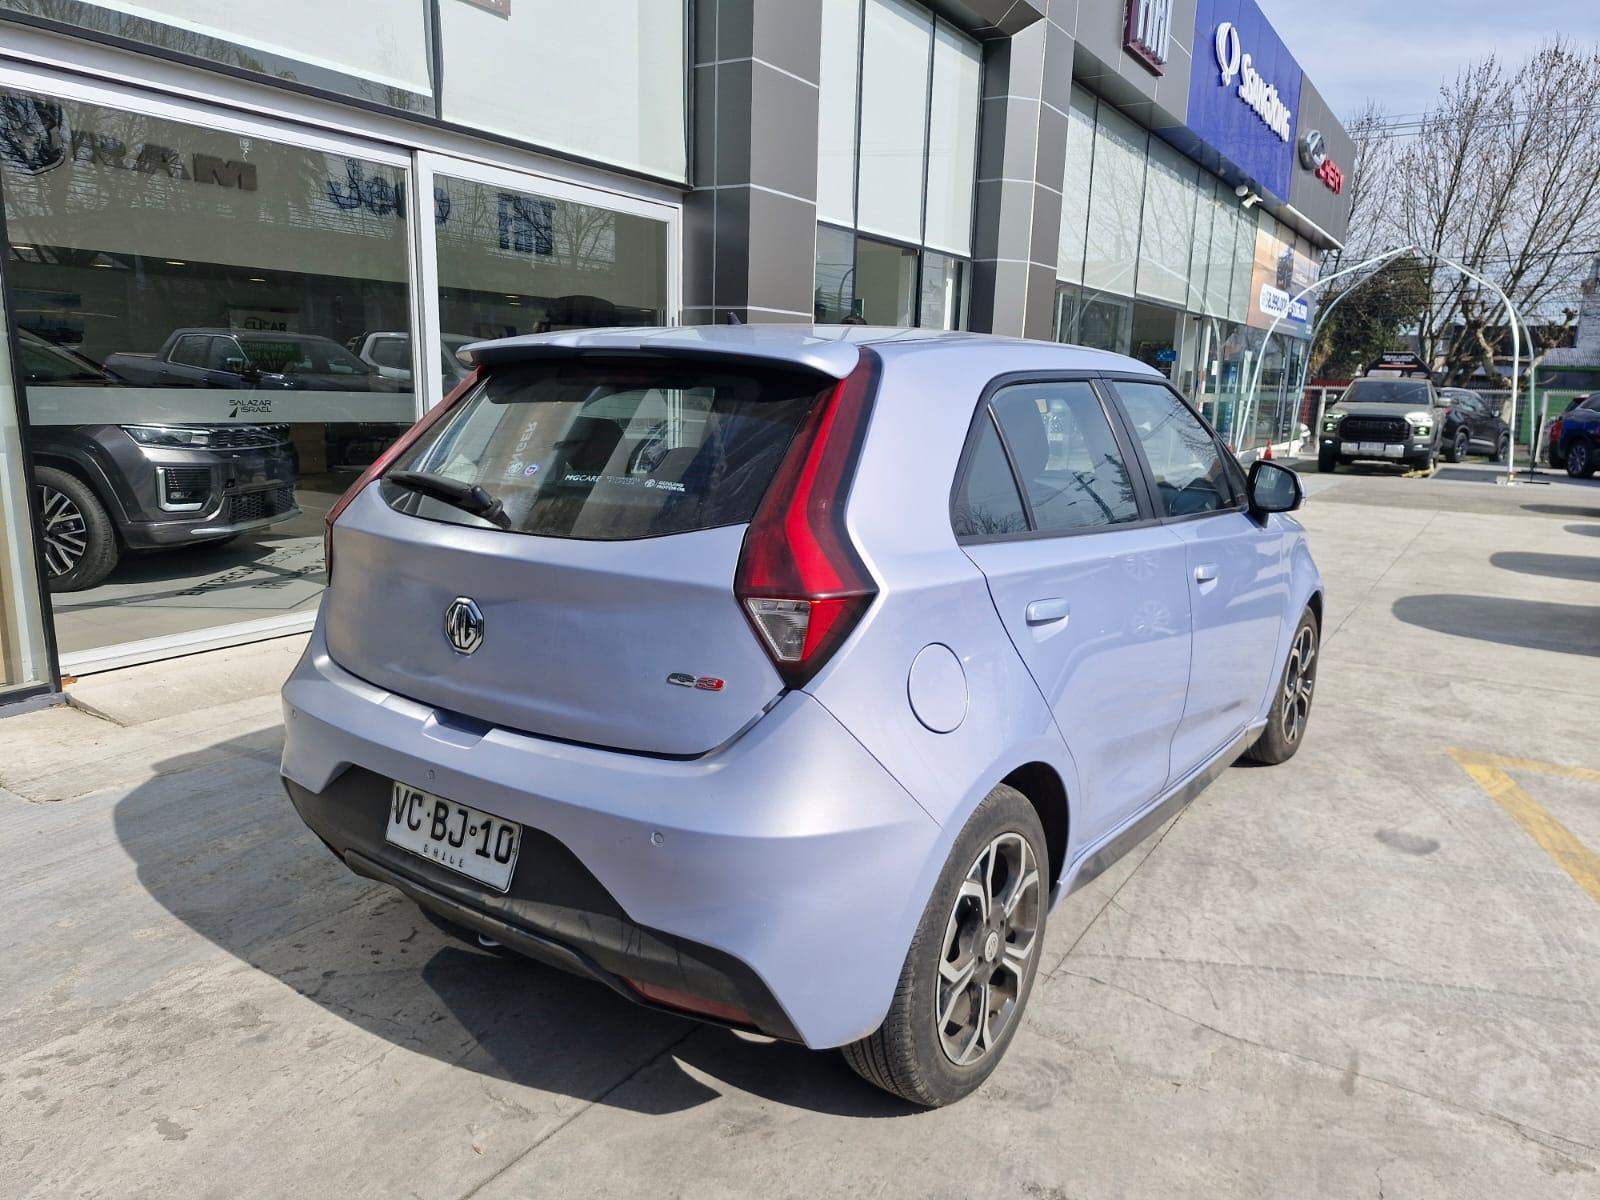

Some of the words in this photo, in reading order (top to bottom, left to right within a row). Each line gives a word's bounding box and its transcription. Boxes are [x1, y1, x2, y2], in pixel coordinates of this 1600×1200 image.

[229, 399, 272, 407] SALAZAR
[447, 600, 480, 651] MG
[422, 843, 466, 869] CHILE
